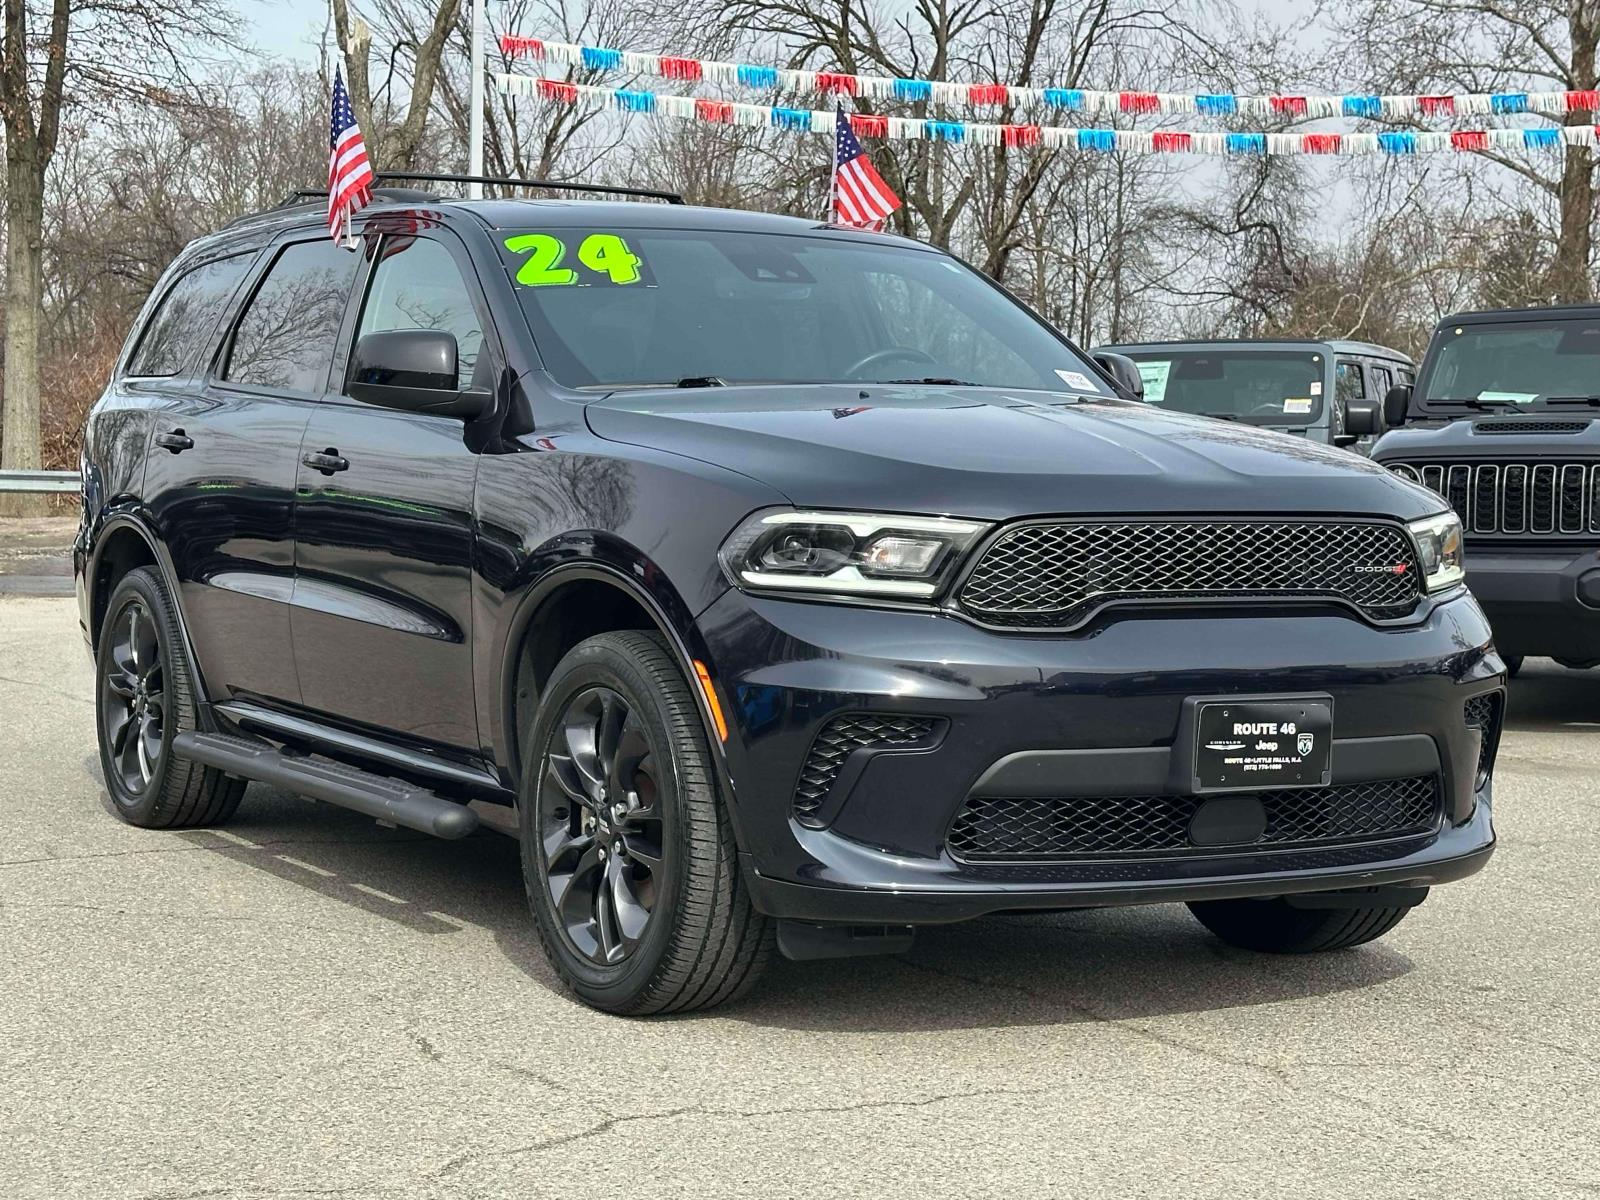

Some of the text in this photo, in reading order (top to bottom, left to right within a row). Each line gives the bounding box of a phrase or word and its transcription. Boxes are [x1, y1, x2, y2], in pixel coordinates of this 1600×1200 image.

[503, 233, 643, 287] 24
[1233, 723, 1296, 735] ROUTE 46
[1255, 740, 1278, 752] Jeep
